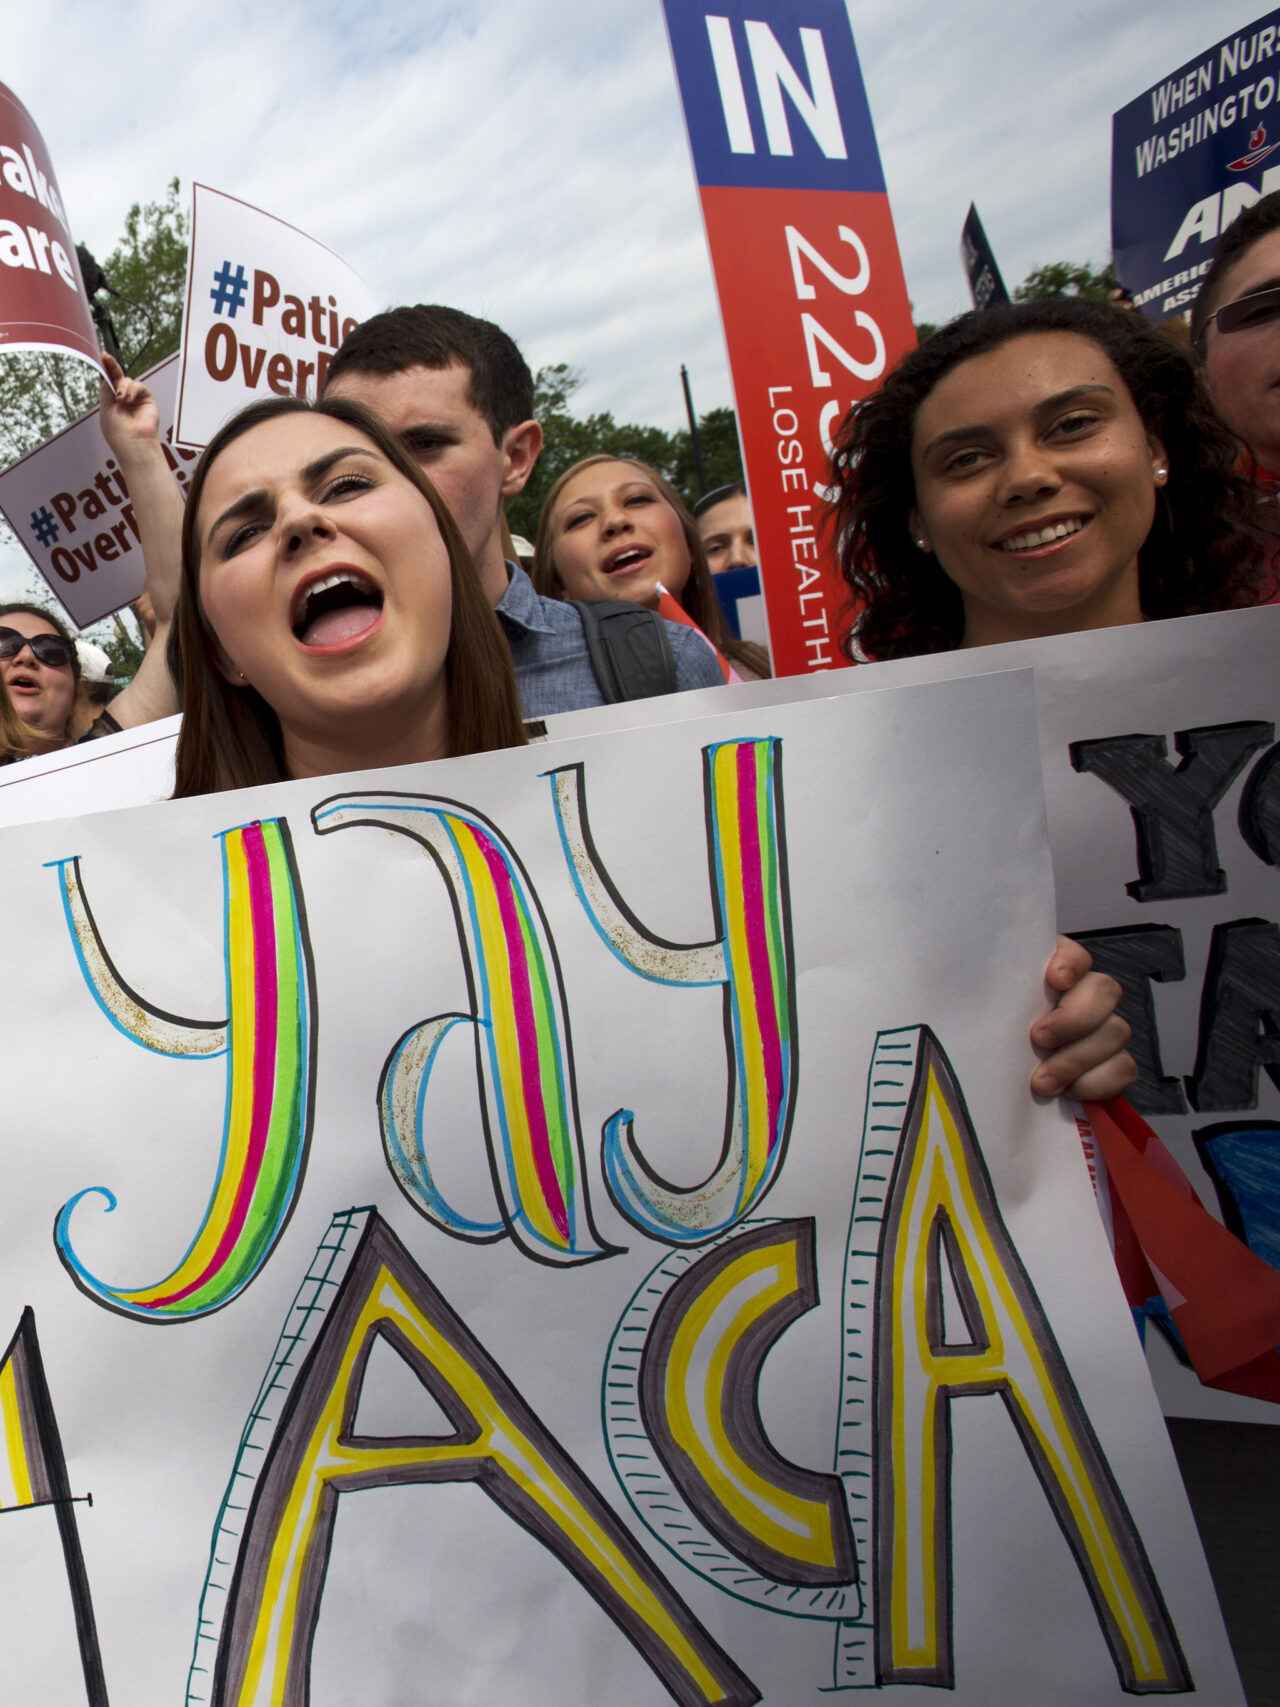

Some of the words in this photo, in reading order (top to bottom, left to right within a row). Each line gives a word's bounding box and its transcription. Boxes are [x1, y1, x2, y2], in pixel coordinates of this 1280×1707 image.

[705, 15, 847, 160] IN
[1135, 69, 1280, 179] WASHINGTO
[1151, 59, 1214, 125] WHEN
[768, 386, 808, 492] LOSE
[787, 505, 832, 673] HEALTH
[184, 1023, 1194, 1707] ACA
